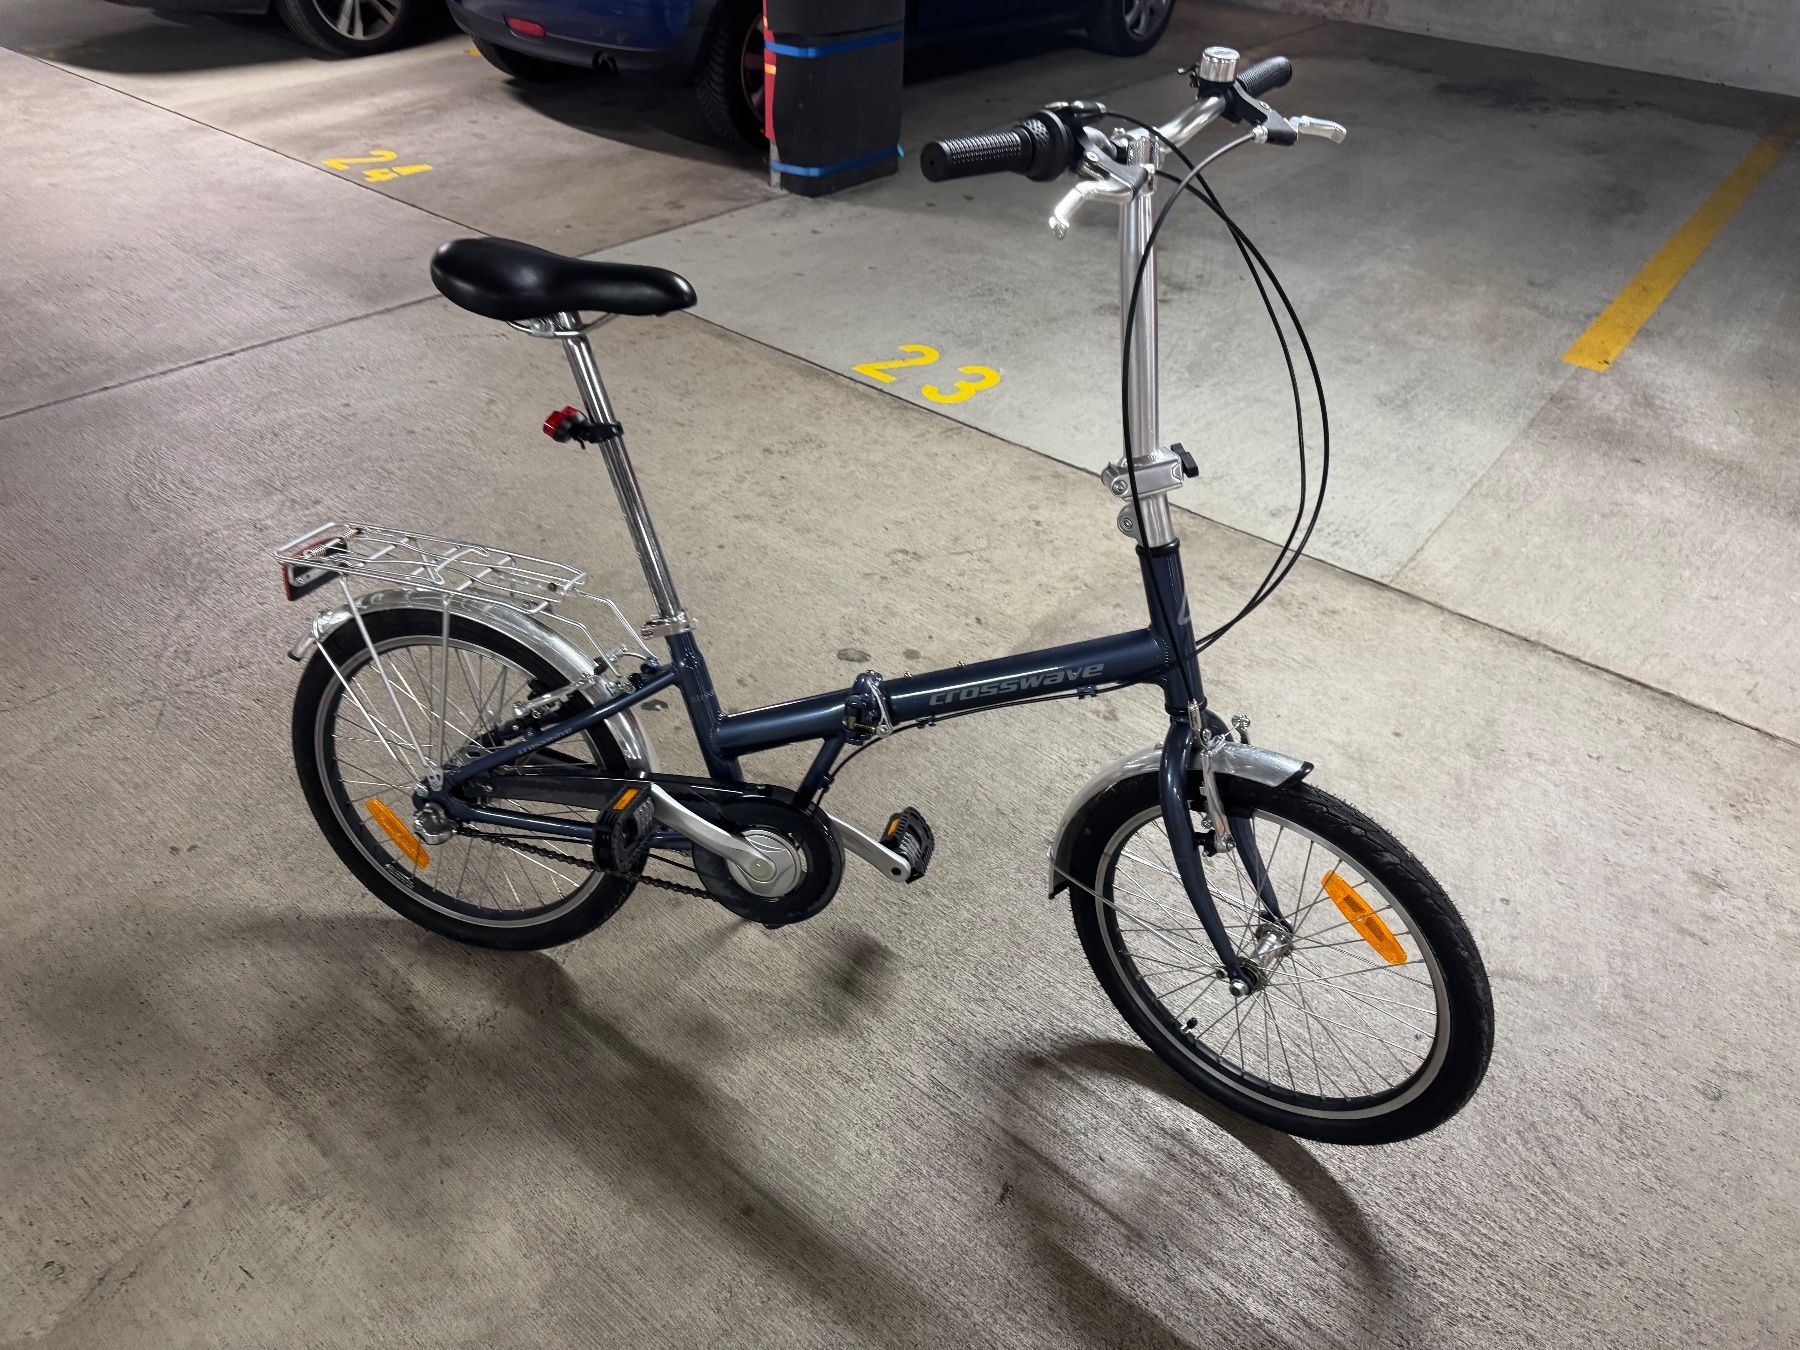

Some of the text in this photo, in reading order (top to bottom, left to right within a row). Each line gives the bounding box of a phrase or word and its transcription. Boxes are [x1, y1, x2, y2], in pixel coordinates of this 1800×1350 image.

[321, 149, 433, 183] 24
[851, 344, 1001, 404] 23
[928, 663, 1105, 706] crosswave
